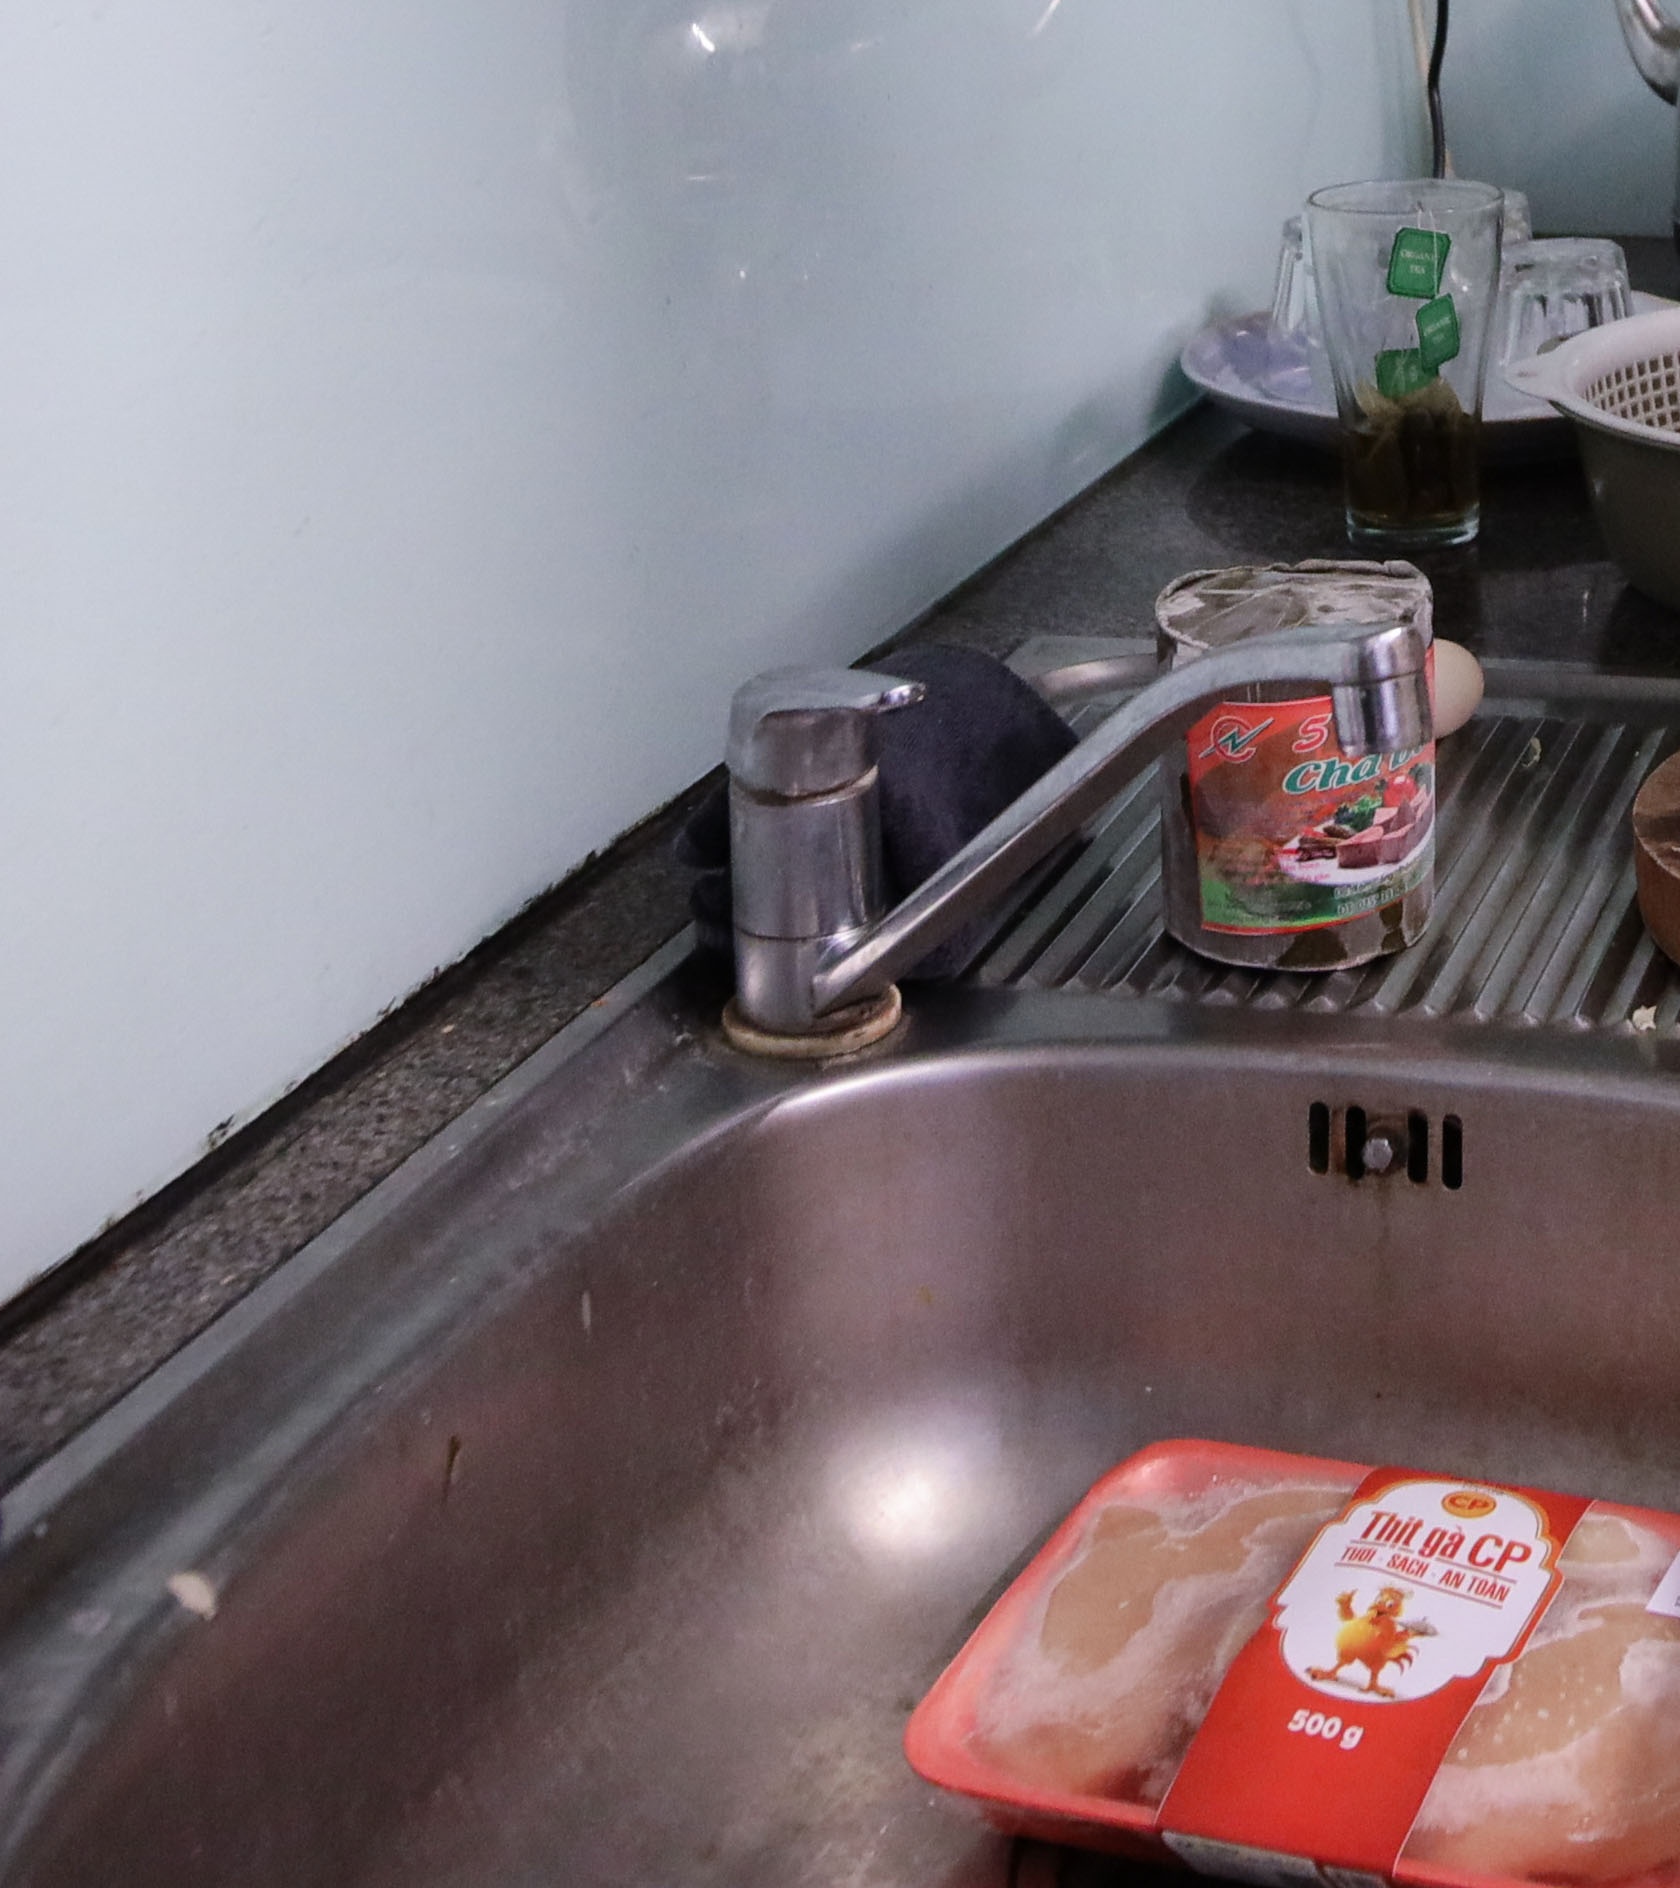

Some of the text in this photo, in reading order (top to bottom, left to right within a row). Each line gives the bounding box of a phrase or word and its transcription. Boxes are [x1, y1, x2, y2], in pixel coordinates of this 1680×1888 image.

[1448, 1494, 1490, 1510] CP
[1361, 1510, 1532, 1573] Thịt gà CP
[1439, 1571, 1465, 1589] AN
[1287, 1709, 1364, 1750] 500 g
